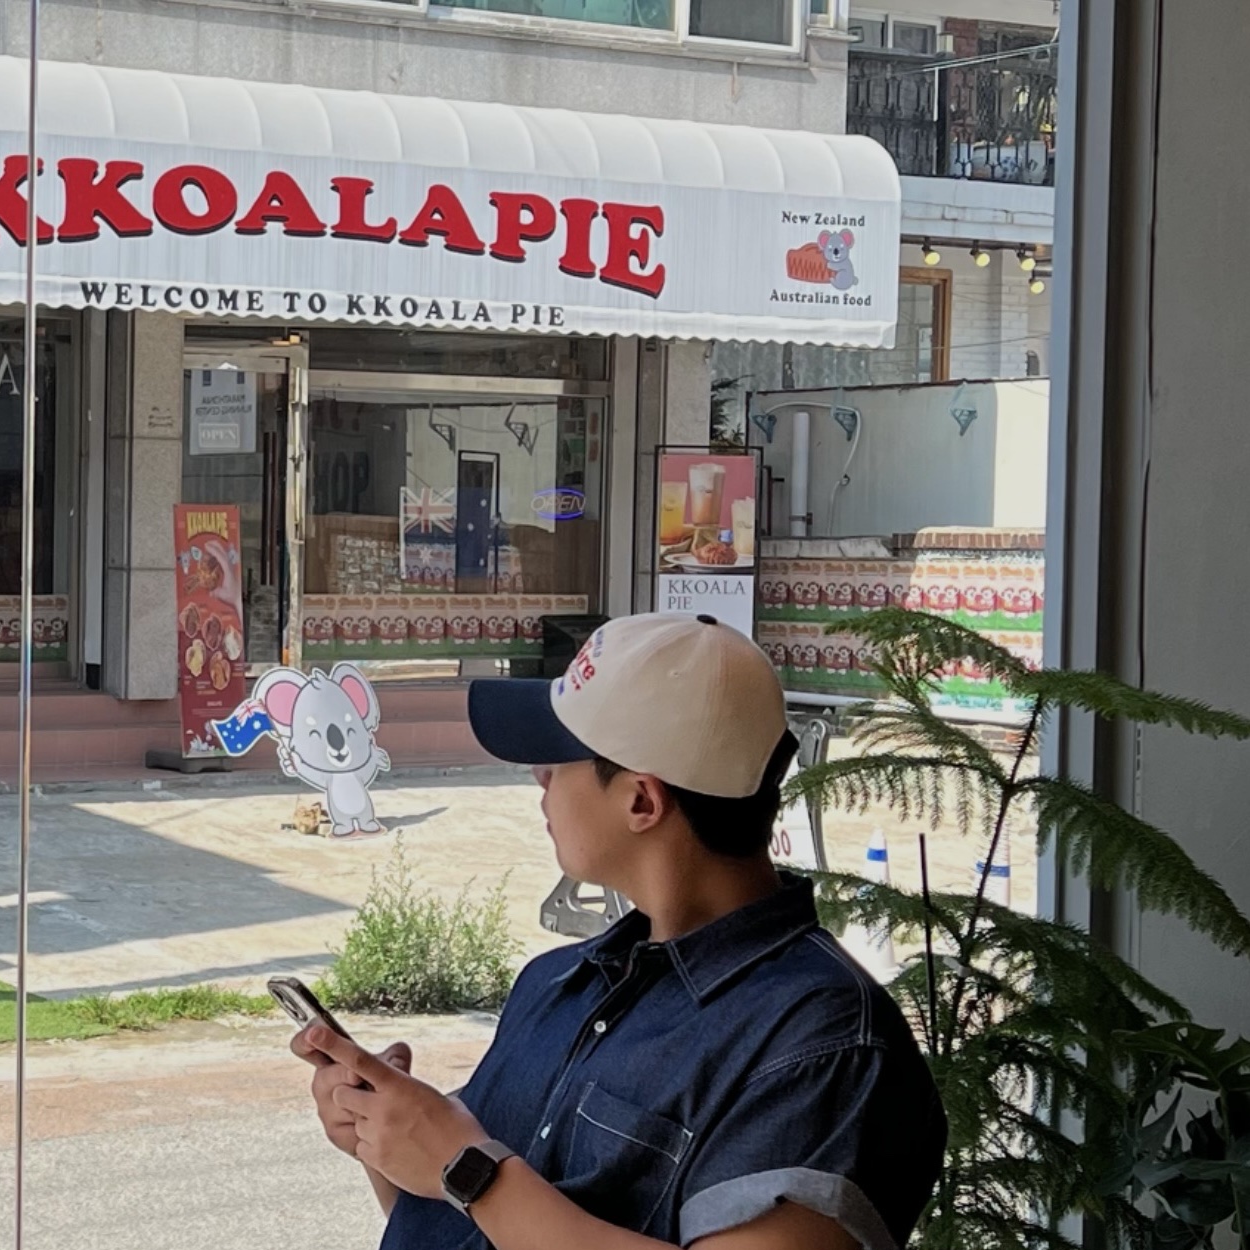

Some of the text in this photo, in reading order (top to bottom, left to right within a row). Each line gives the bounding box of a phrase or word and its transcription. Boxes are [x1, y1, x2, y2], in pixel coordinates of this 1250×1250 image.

[780, 210, 867, 229] New Zealand
[80, 281, 565, 327] WELCOME TO KKOALA PIE
[769, 288, 873, 308] Australian food
[201, 430, 237, 441] OPEN
[530, 495, 586, 513] OPEN
[667, 578, 746, 597] KKOALA
[667, 595, 693, 611] PIE
